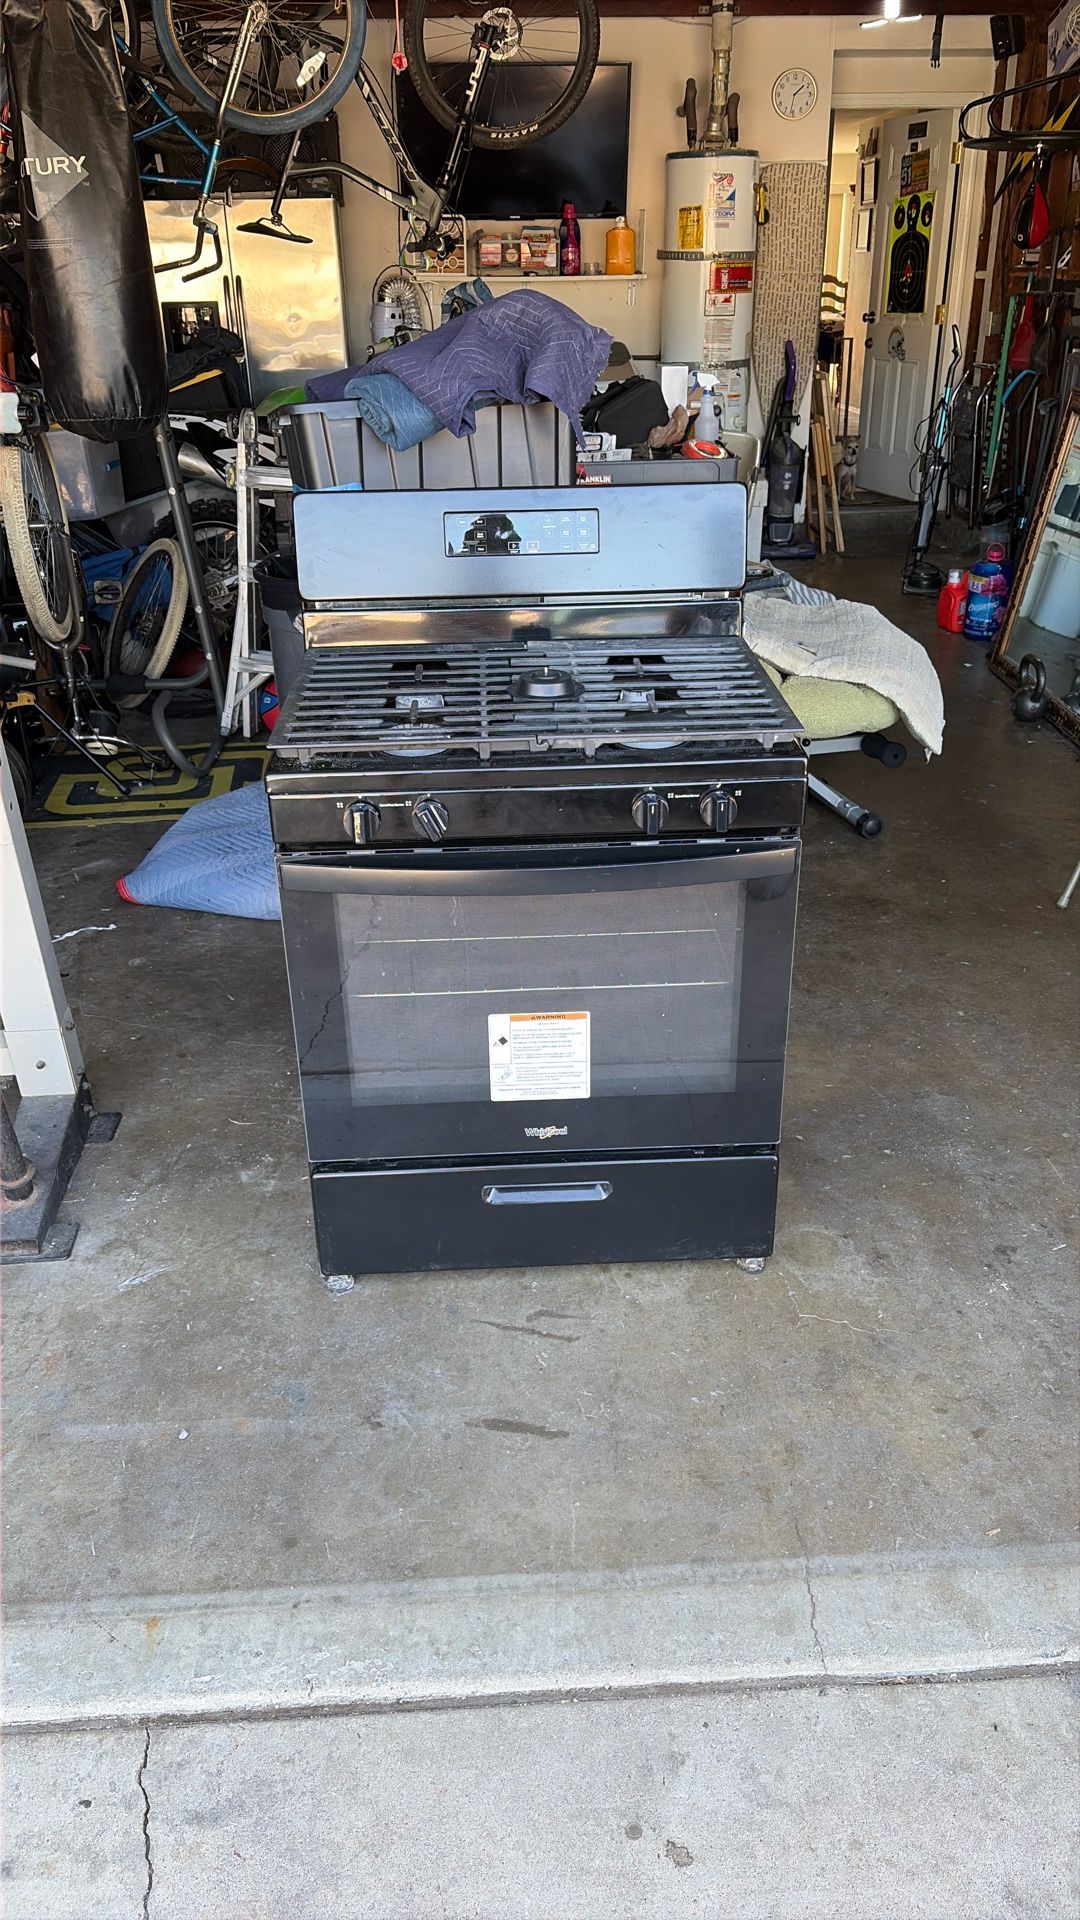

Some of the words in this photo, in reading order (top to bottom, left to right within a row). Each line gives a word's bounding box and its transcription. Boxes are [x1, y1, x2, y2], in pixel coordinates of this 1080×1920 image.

[490, 123, 540, 139] MAXXIS
[21, 155, 86, 177] TURY
[524, 1126, 568, 1140] Whirlpool
